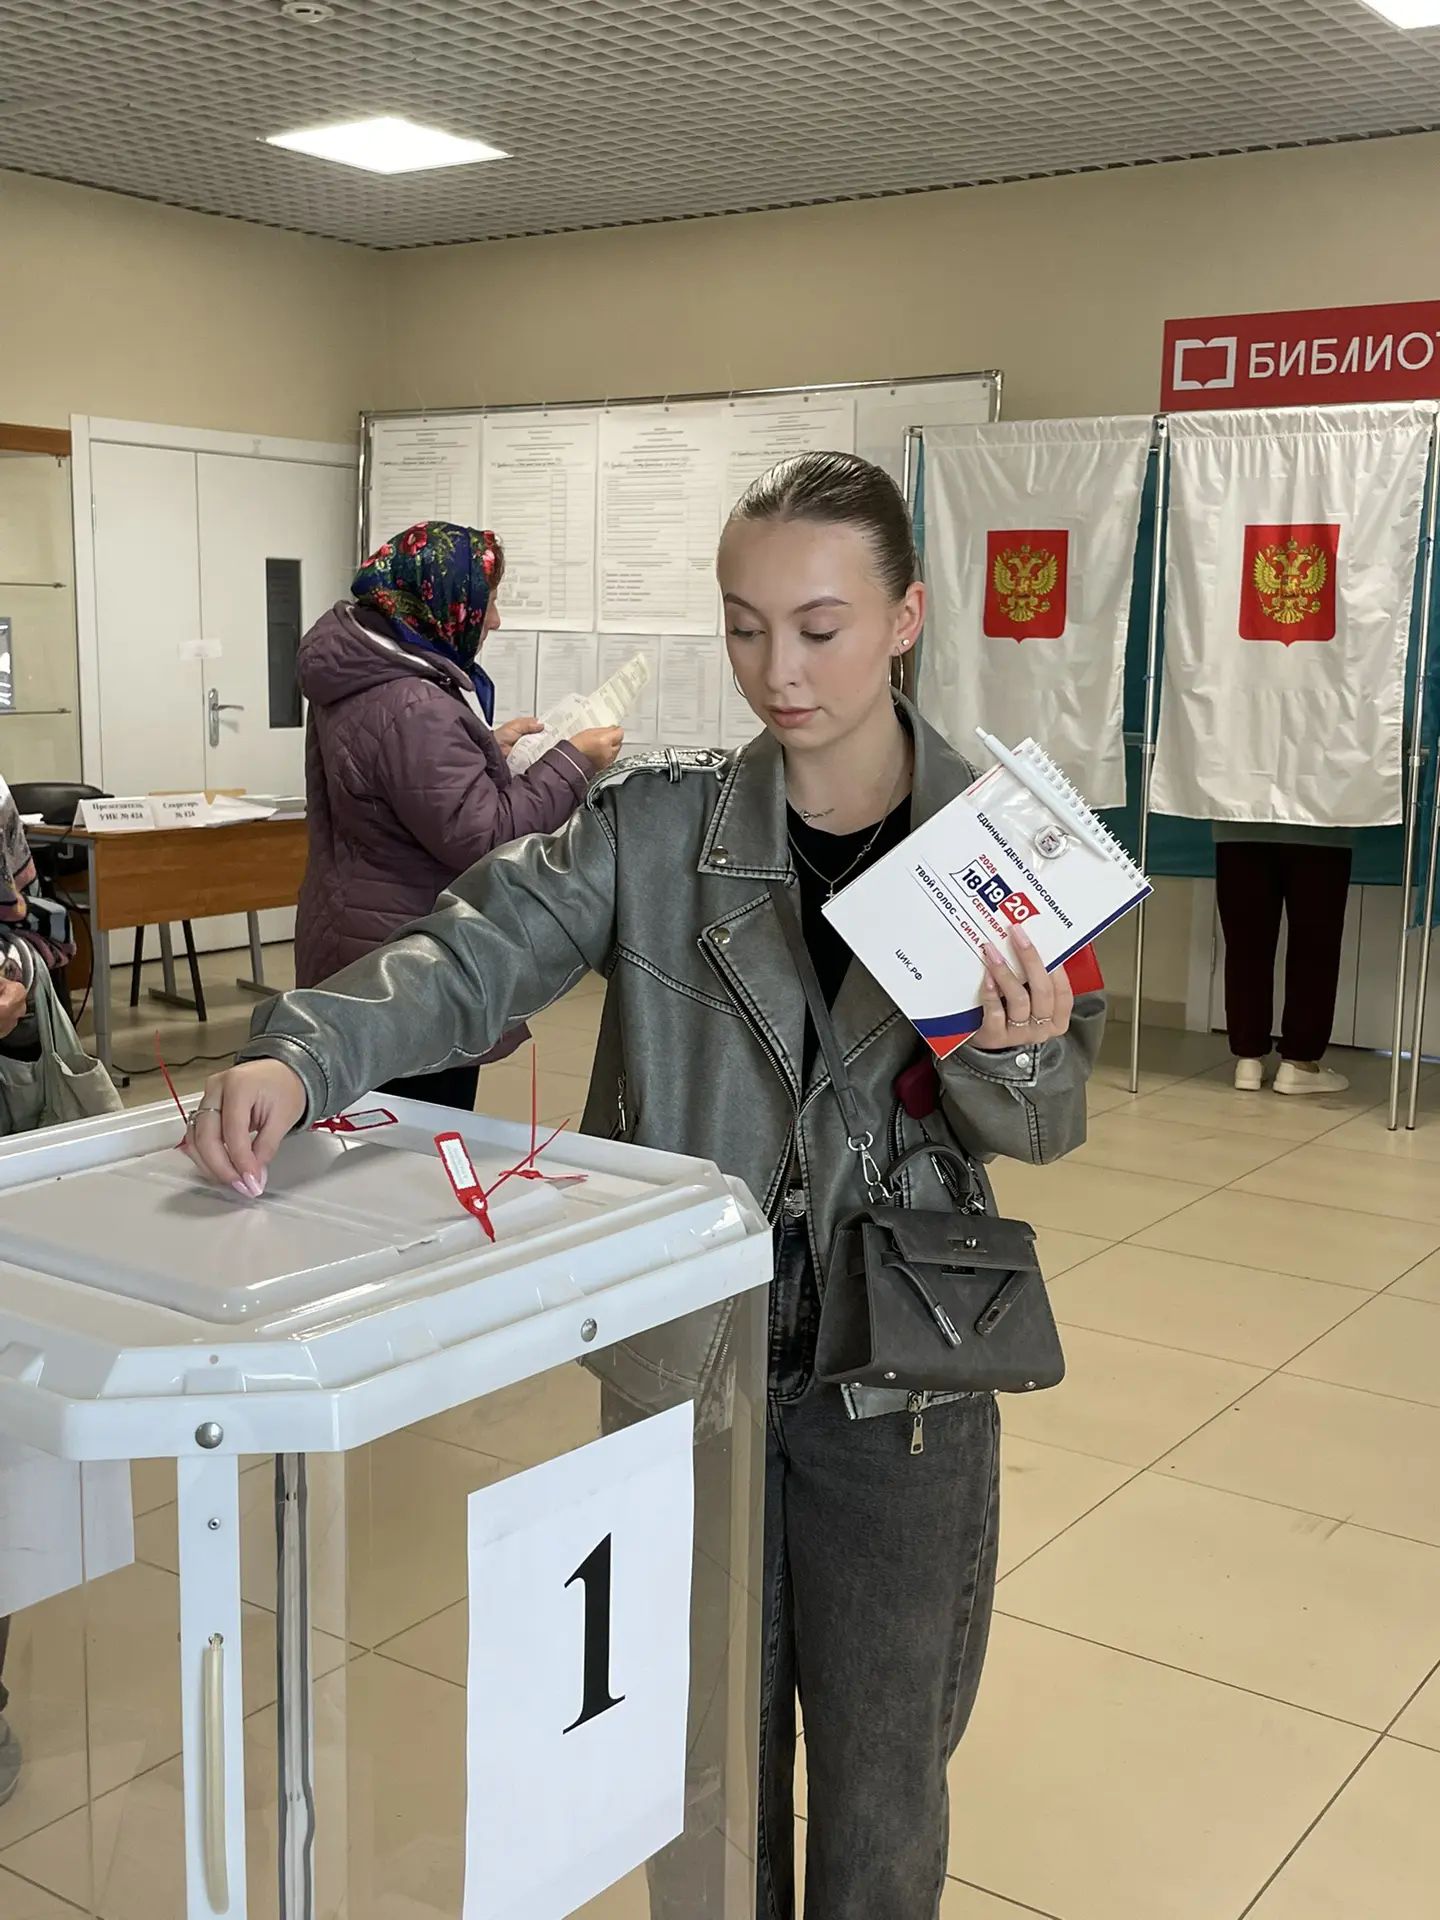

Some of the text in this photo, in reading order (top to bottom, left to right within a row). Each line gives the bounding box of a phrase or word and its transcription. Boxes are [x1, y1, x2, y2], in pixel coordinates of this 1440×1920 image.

[1249, 331, 1440, 379] БИБЛИО
[976, 812, 1074, 929] ЕДИНЫЙ ДЕНЬ ГОЛОСОВАНИЯ
[978, 853, 998, 875] 2026
[914, 864, 936, 889] ТВОЙ
[932, 887, 957, 915] ГОЛОС
[960, 920, 980, 945] СИЛА
[961, 868, 1030, 922] 18 19 20
[971, 897, 1008, 940] СЕНТЯБРЯ
[895, 948, 923, 981] ЦИК.РФ
[563, 1532, 626, 1735] 1
